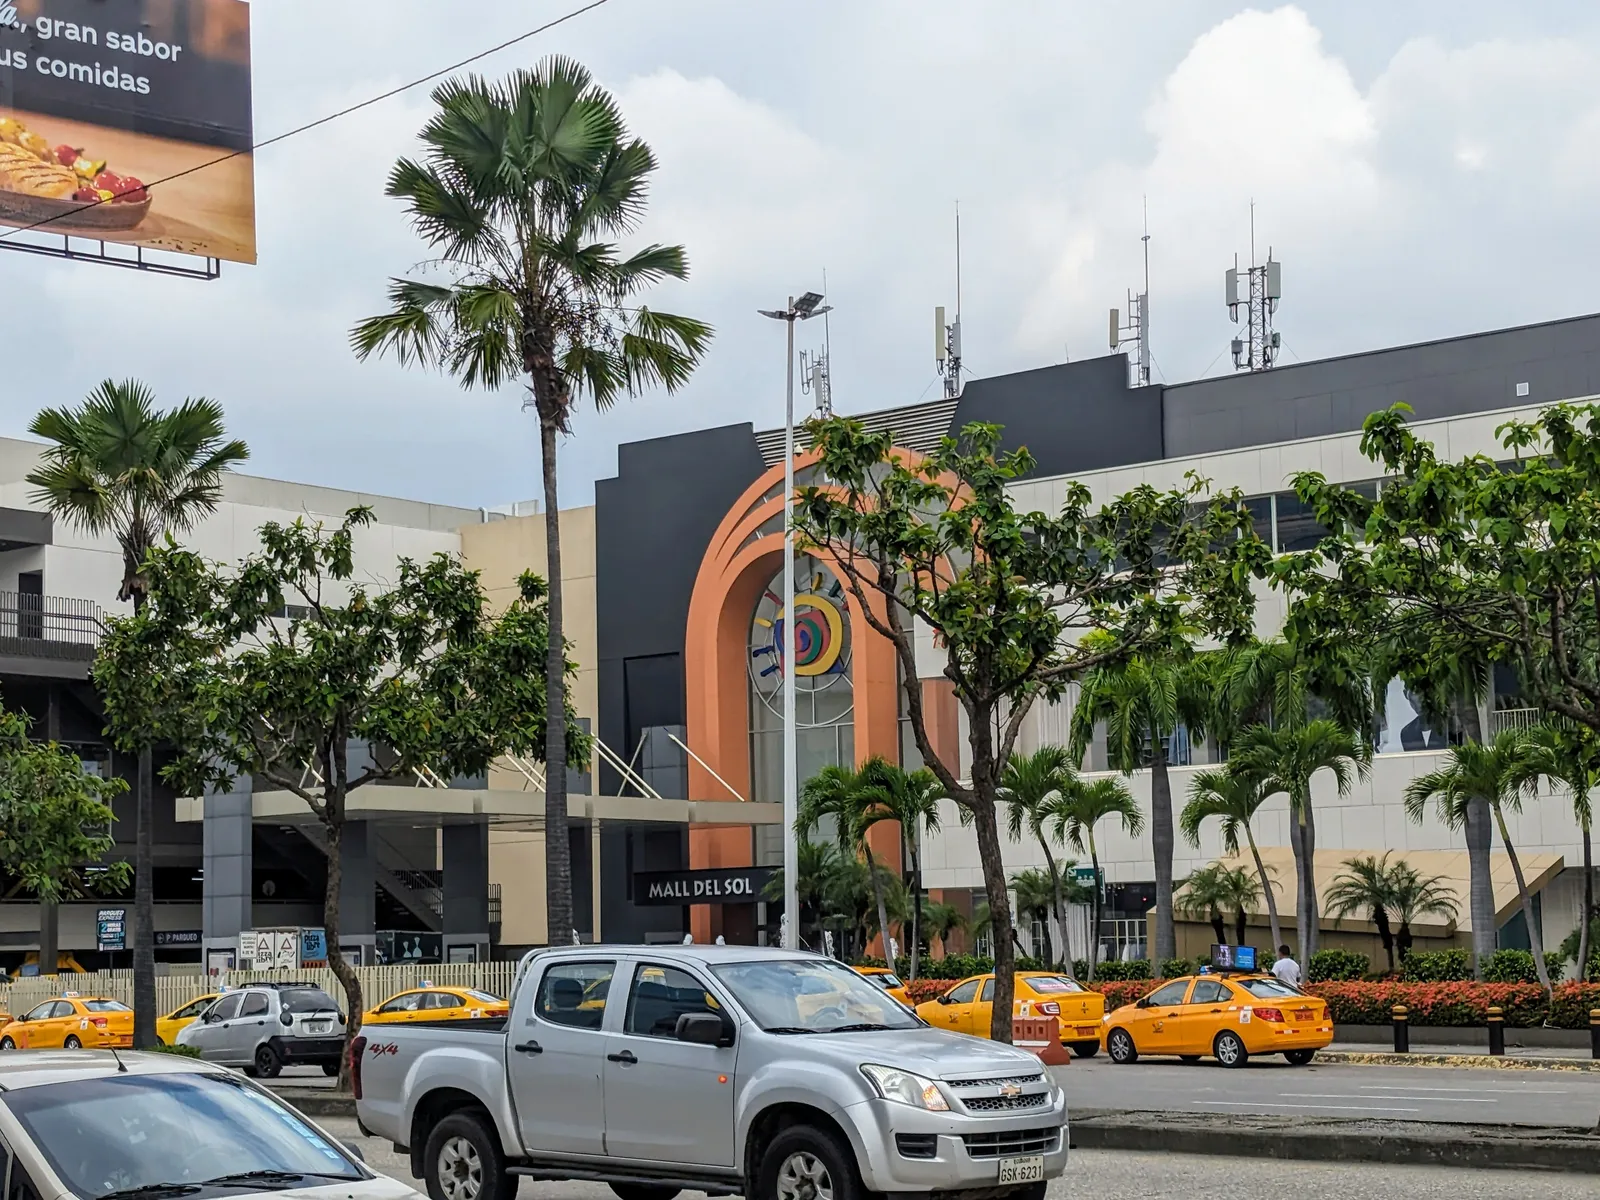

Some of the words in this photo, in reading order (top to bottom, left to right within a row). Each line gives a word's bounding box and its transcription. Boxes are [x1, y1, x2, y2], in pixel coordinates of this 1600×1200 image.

[35, 16, 98, 45] gran
[105, 31, 182, 61] sabor
[35, 56, 151, 94] comidas
[649, 881, 690, 898] MALL
[693, 879, 722, 896] DEL
[724, 877, 753, 895] SOL
[172, 933, 198, 942] PARQUEO
[1001, 1165, 1042, 1182] GSK-6231
